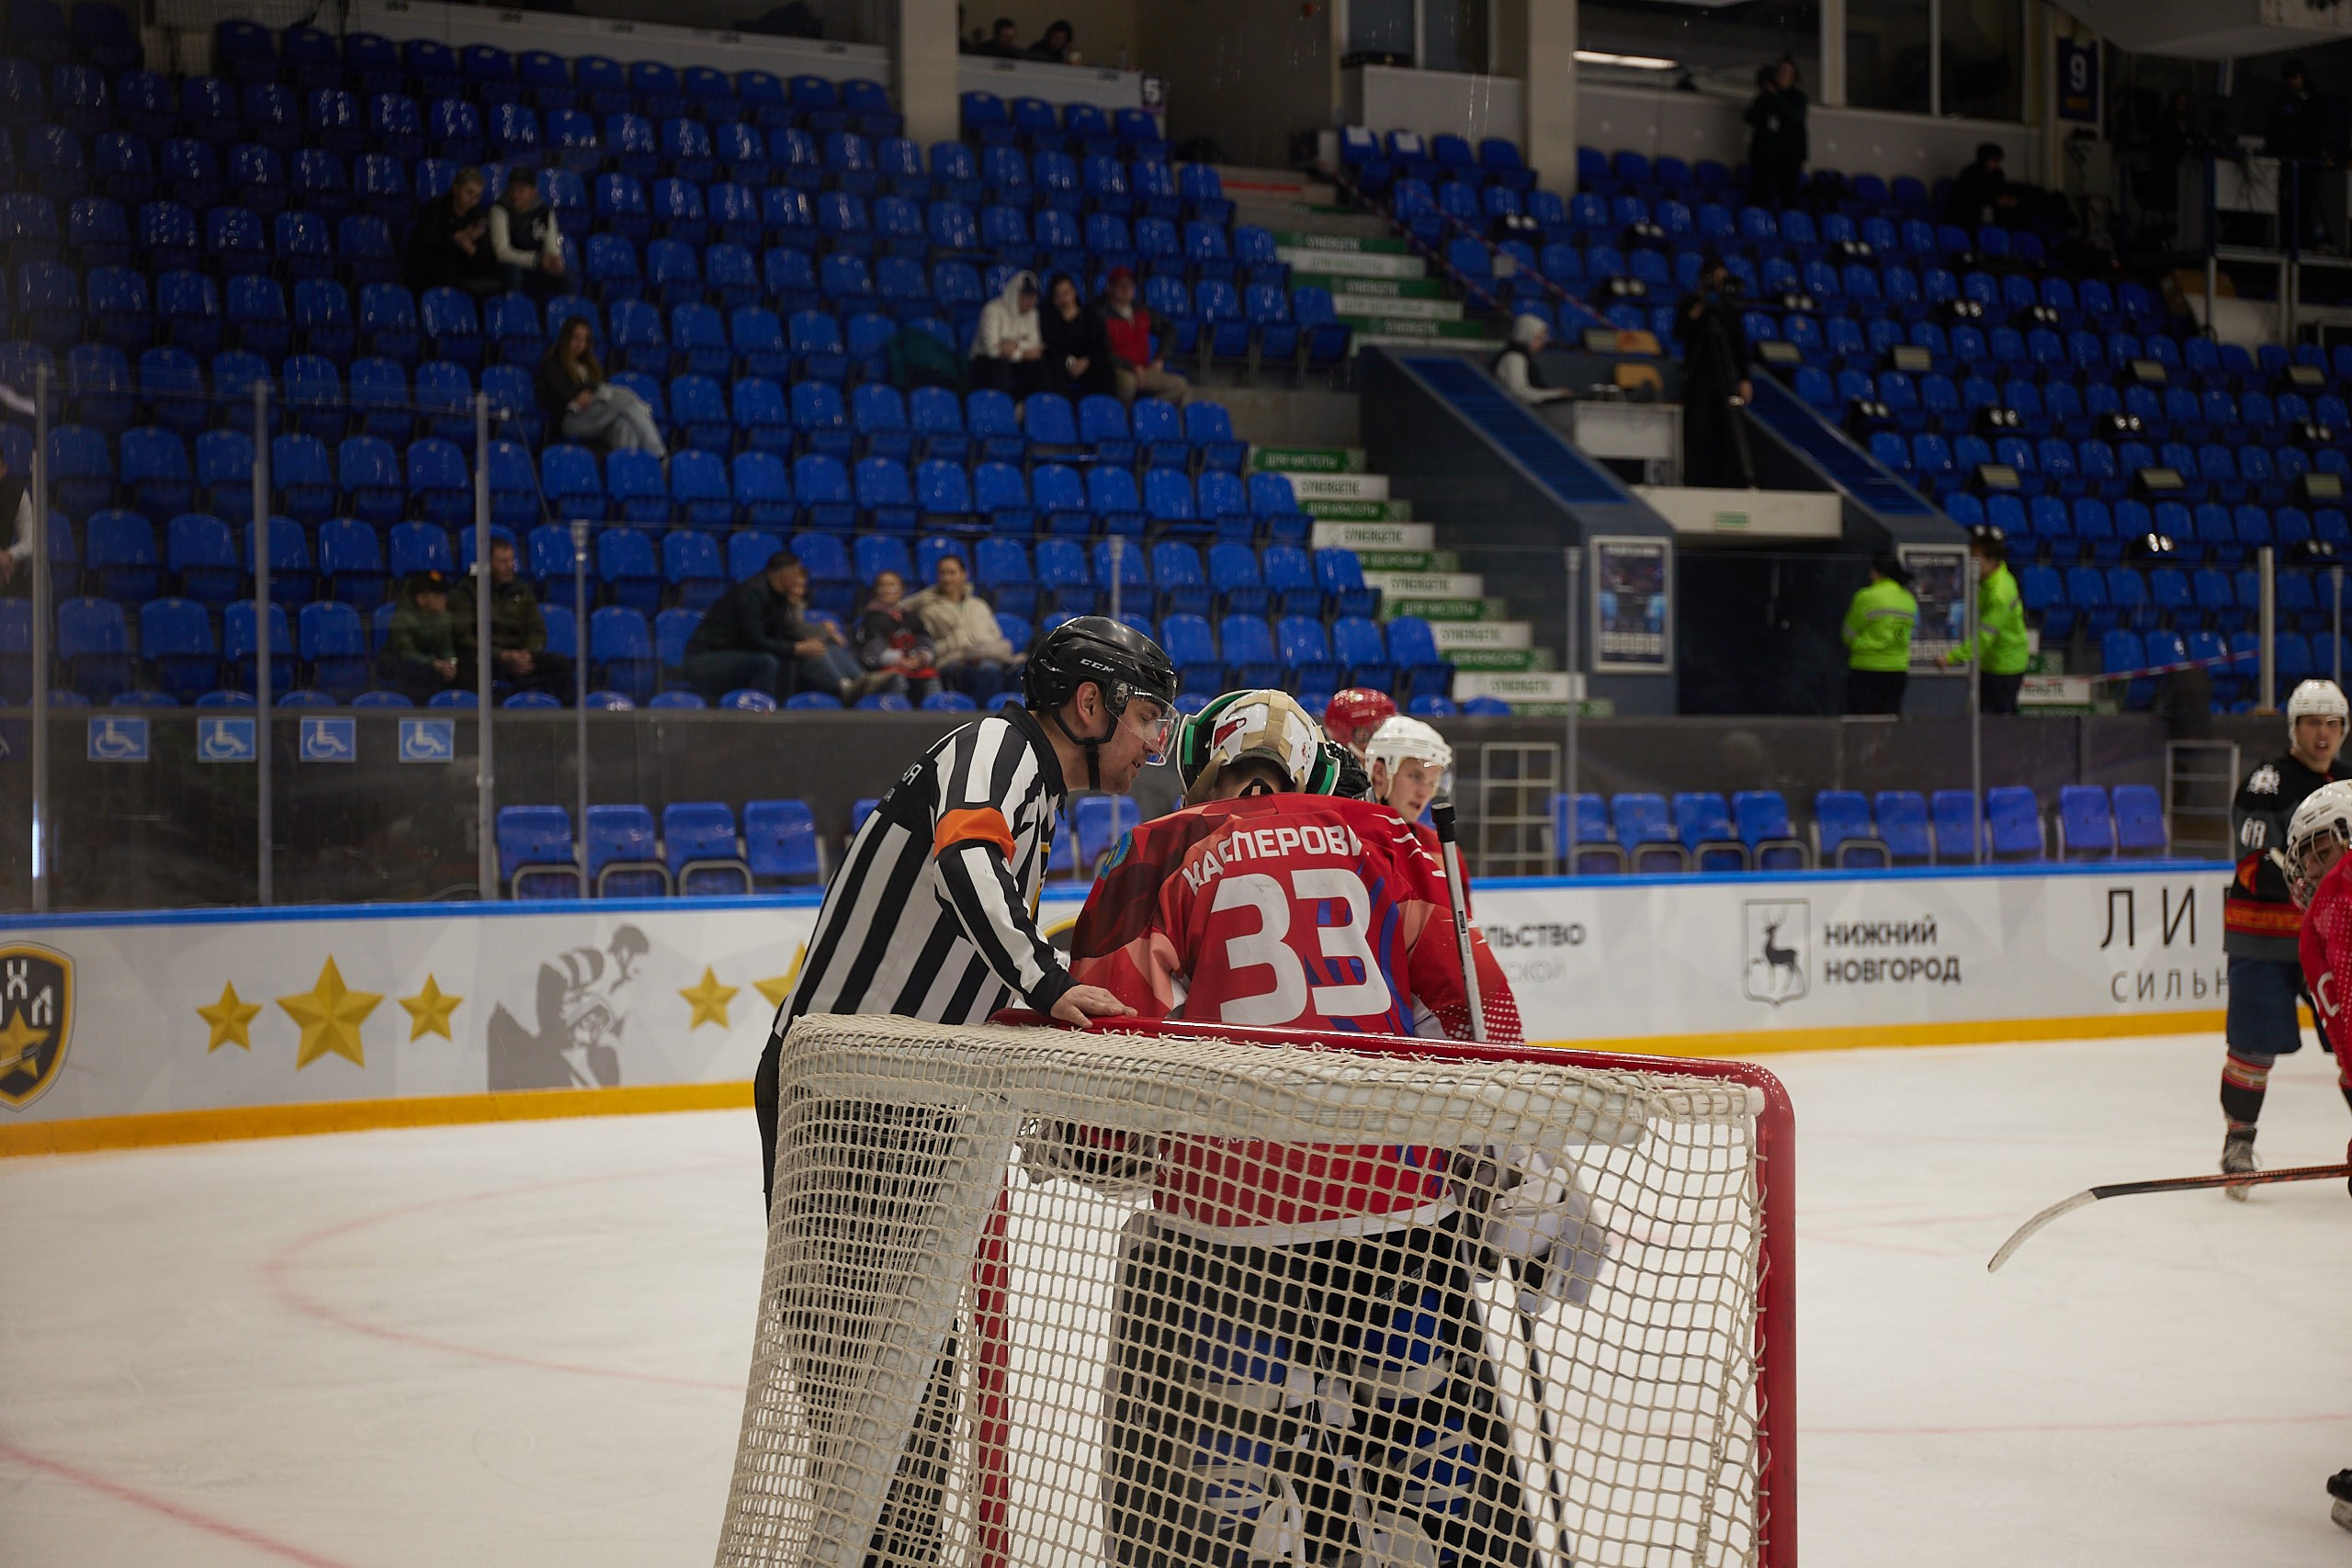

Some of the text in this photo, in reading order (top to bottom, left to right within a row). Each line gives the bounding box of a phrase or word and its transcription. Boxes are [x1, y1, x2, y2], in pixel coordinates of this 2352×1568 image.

[2069, 51, 2088, 93] 9
[1080, 658, 1115, 673] CCM
[1211, 867, 1392, 1026] 33
[1825, 914, 1937, 946] НИЖНИЙ
[1825, 957, 1961, 986] НОВГОРОД
[2111, 968, 2228, 1004] СИЛЬН
